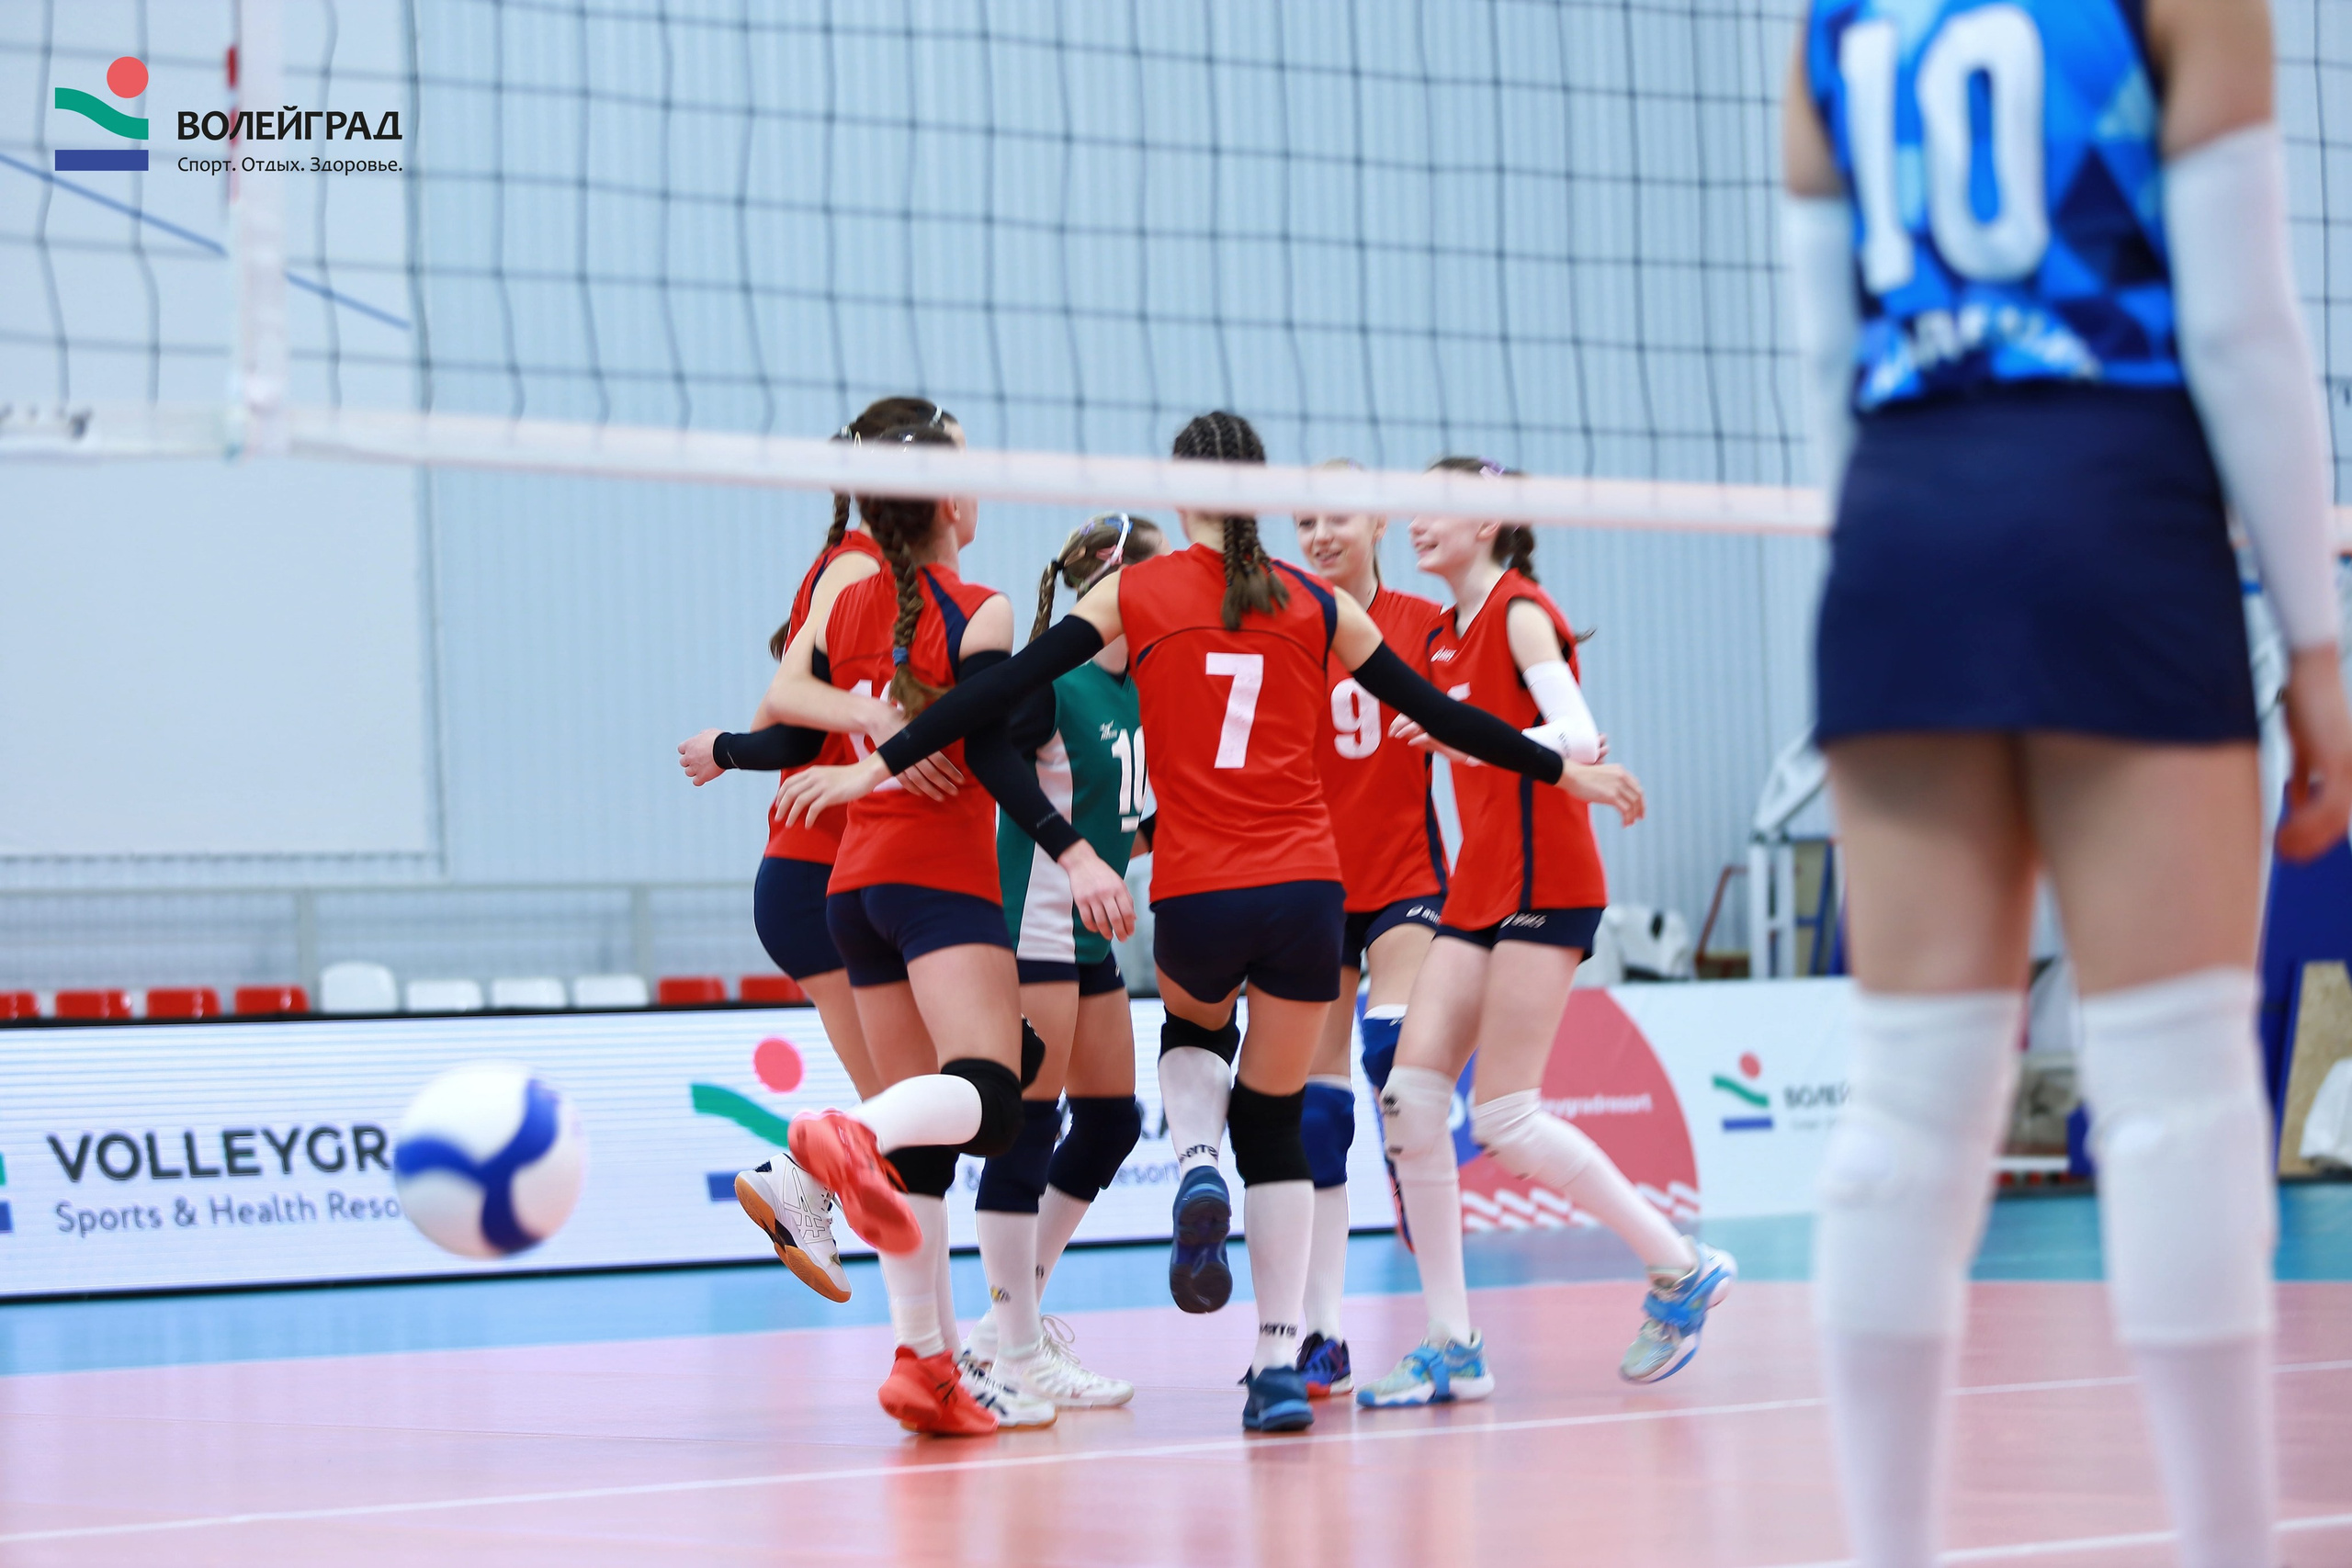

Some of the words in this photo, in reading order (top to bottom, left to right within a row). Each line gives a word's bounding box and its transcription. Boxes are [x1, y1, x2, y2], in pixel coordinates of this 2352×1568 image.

[1839, 5, 2048, 294] 10
[1205, 652, 1264, 769] 7
[1330, 677, 1382, 760] 9
[47, 1125, 392, 1183] VOLLEYGR
[1114, 1161, 1181, 1186] esort
[56, 1199, 163, 1238] Sports
[173, 1193, 198, 1228] &
[209, 1190, 318, 1225] Health
[327, 1188, 401, 1221] Reso
